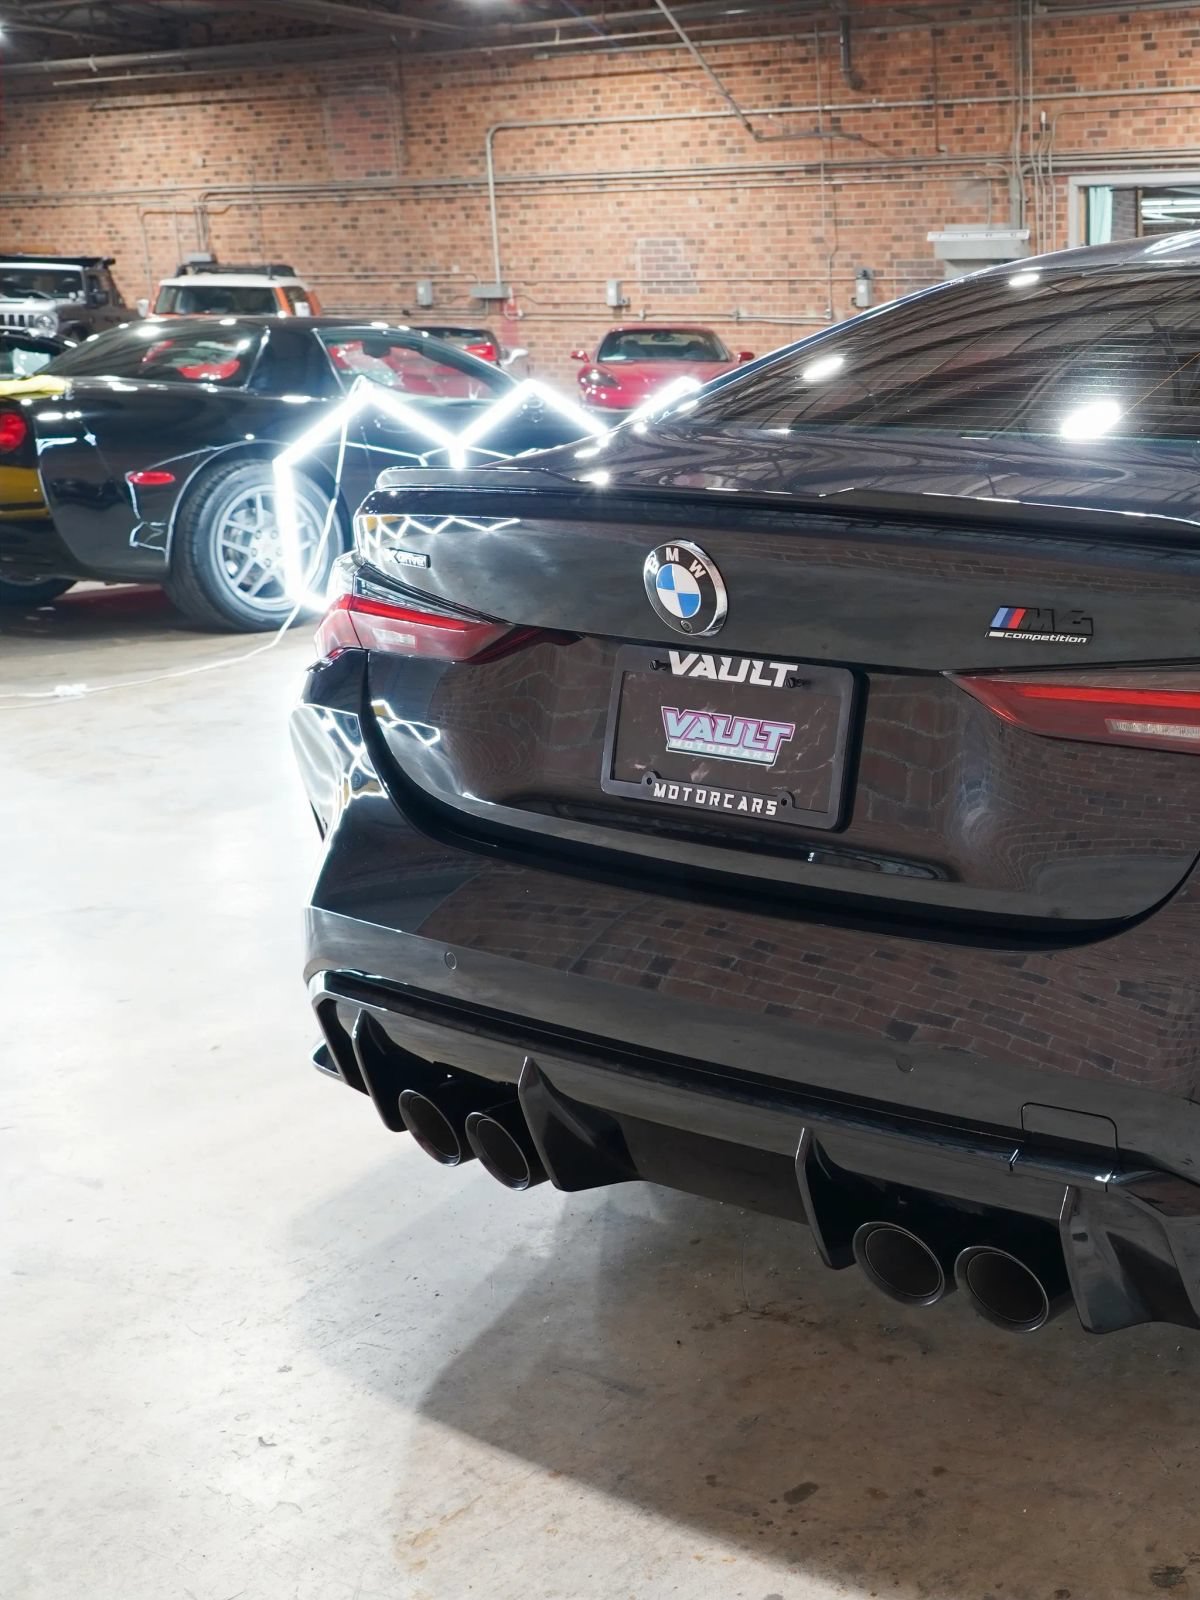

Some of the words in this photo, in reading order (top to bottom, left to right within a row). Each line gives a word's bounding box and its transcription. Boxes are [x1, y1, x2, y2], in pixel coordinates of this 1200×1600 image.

[645, 547, 707, 579] BMW
[1004, 632, 1088, 644] competition
[668, 650, 799, 688] VAULT
[664, 710, 793, 752] VAULT
[653, 782, 778, 816] MOTORCARS
